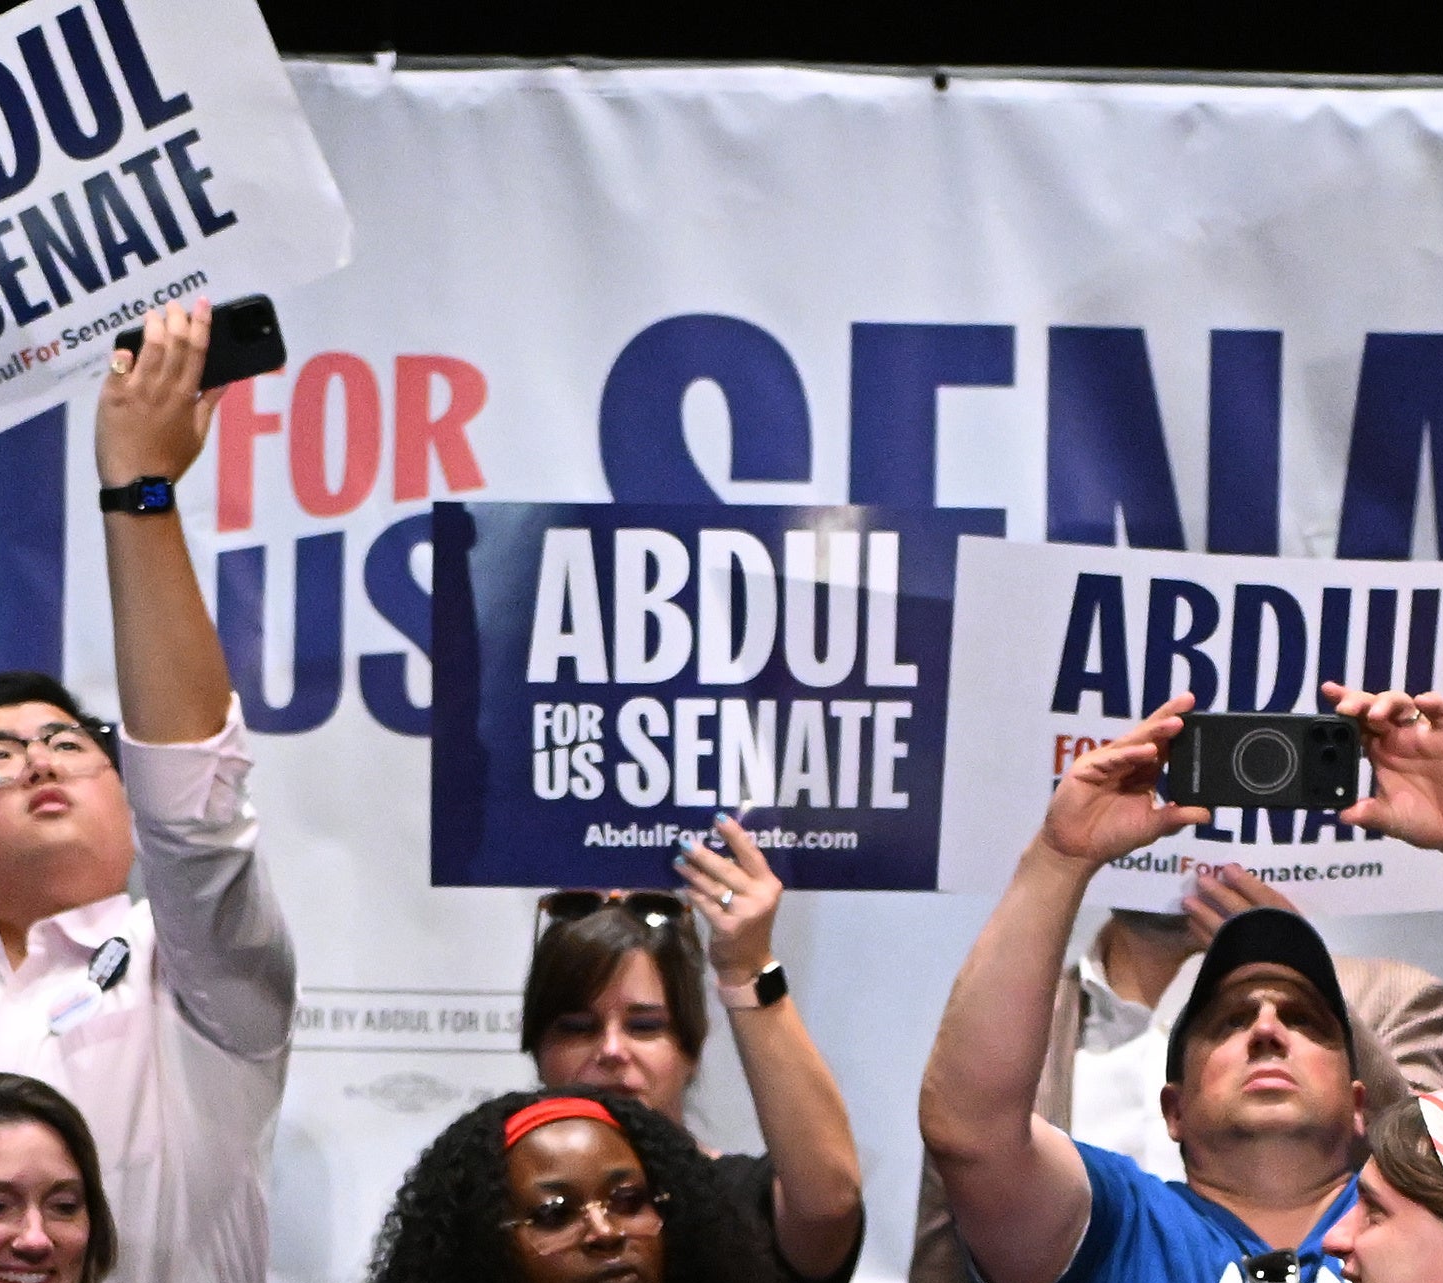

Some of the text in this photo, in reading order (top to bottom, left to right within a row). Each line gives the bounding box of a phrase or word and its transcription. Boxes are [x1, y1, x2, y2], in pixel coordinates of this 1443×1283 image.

[215, 351, 489, 532] FOR
[213, 512, 432, 738] US
[526, 528, 919, 688] ABDUL
[533, 702, 603, 750] FOR
[533, 697, 910, 809] US SENATE
[584, 824, 858, 852] AbdulForSnate.com
[1108, 852, 1383, 883] bdulForenate.com
